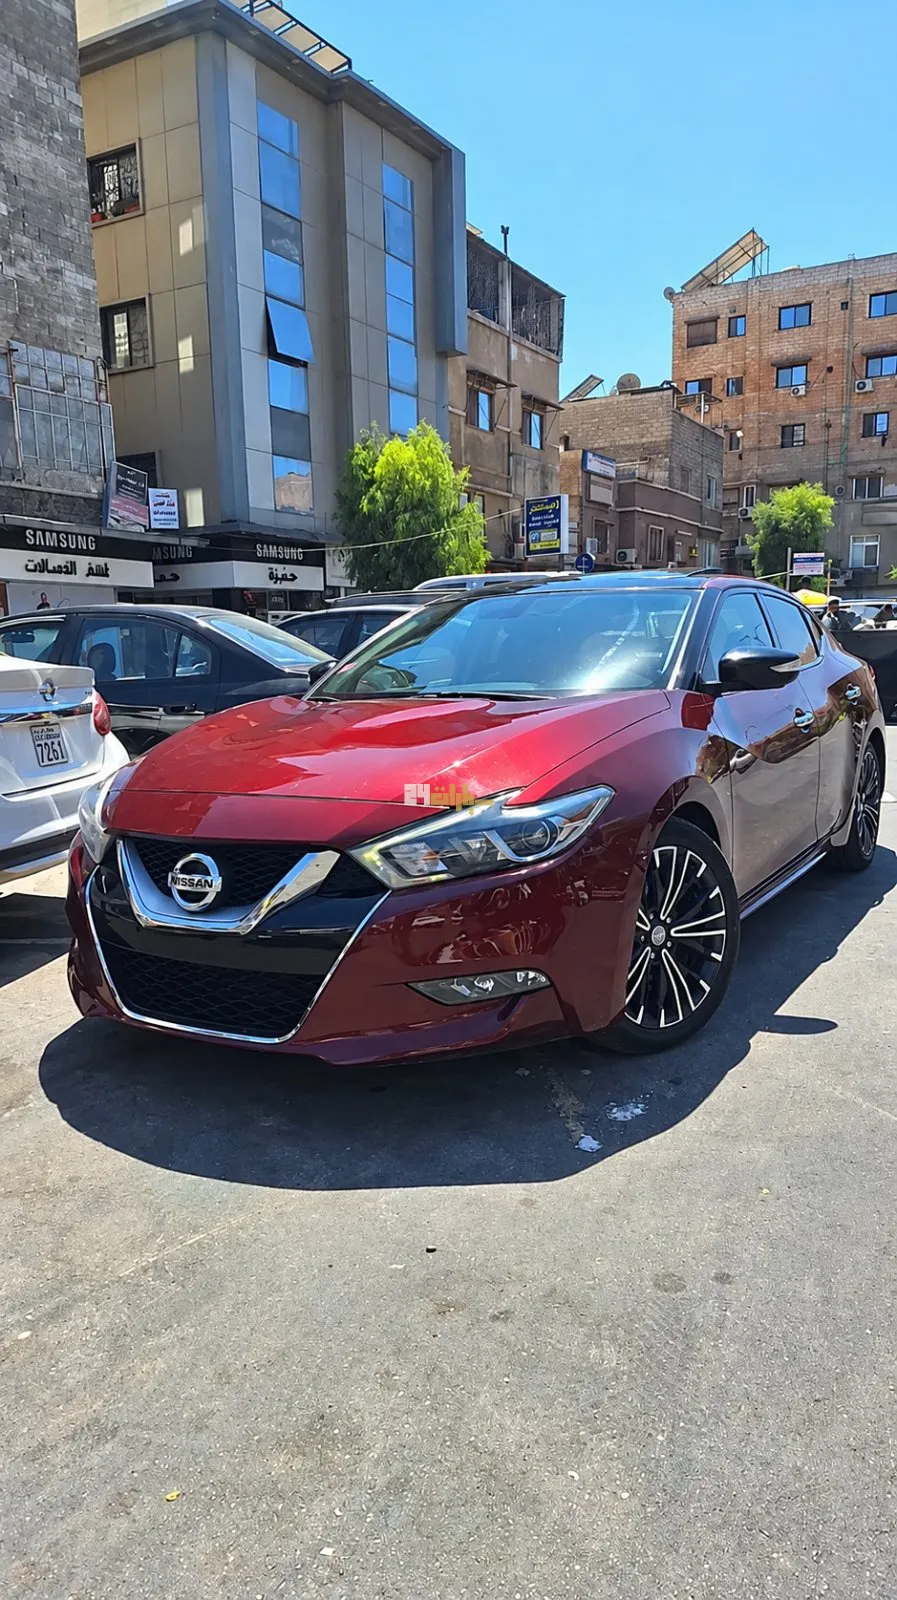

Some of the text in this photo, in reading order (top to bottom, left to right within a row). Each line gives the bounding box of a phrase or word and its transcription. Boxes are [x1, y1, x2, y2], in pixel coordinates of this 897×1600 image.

[25, 529, 97, 551] SAMSUNG
[152, 545, 193, 561] MSUNG
[256, 543, 303, 560] SAMSUNG
[36, 740, 65, 764] 7261
[171, 875, 214, 889] NISSAN
